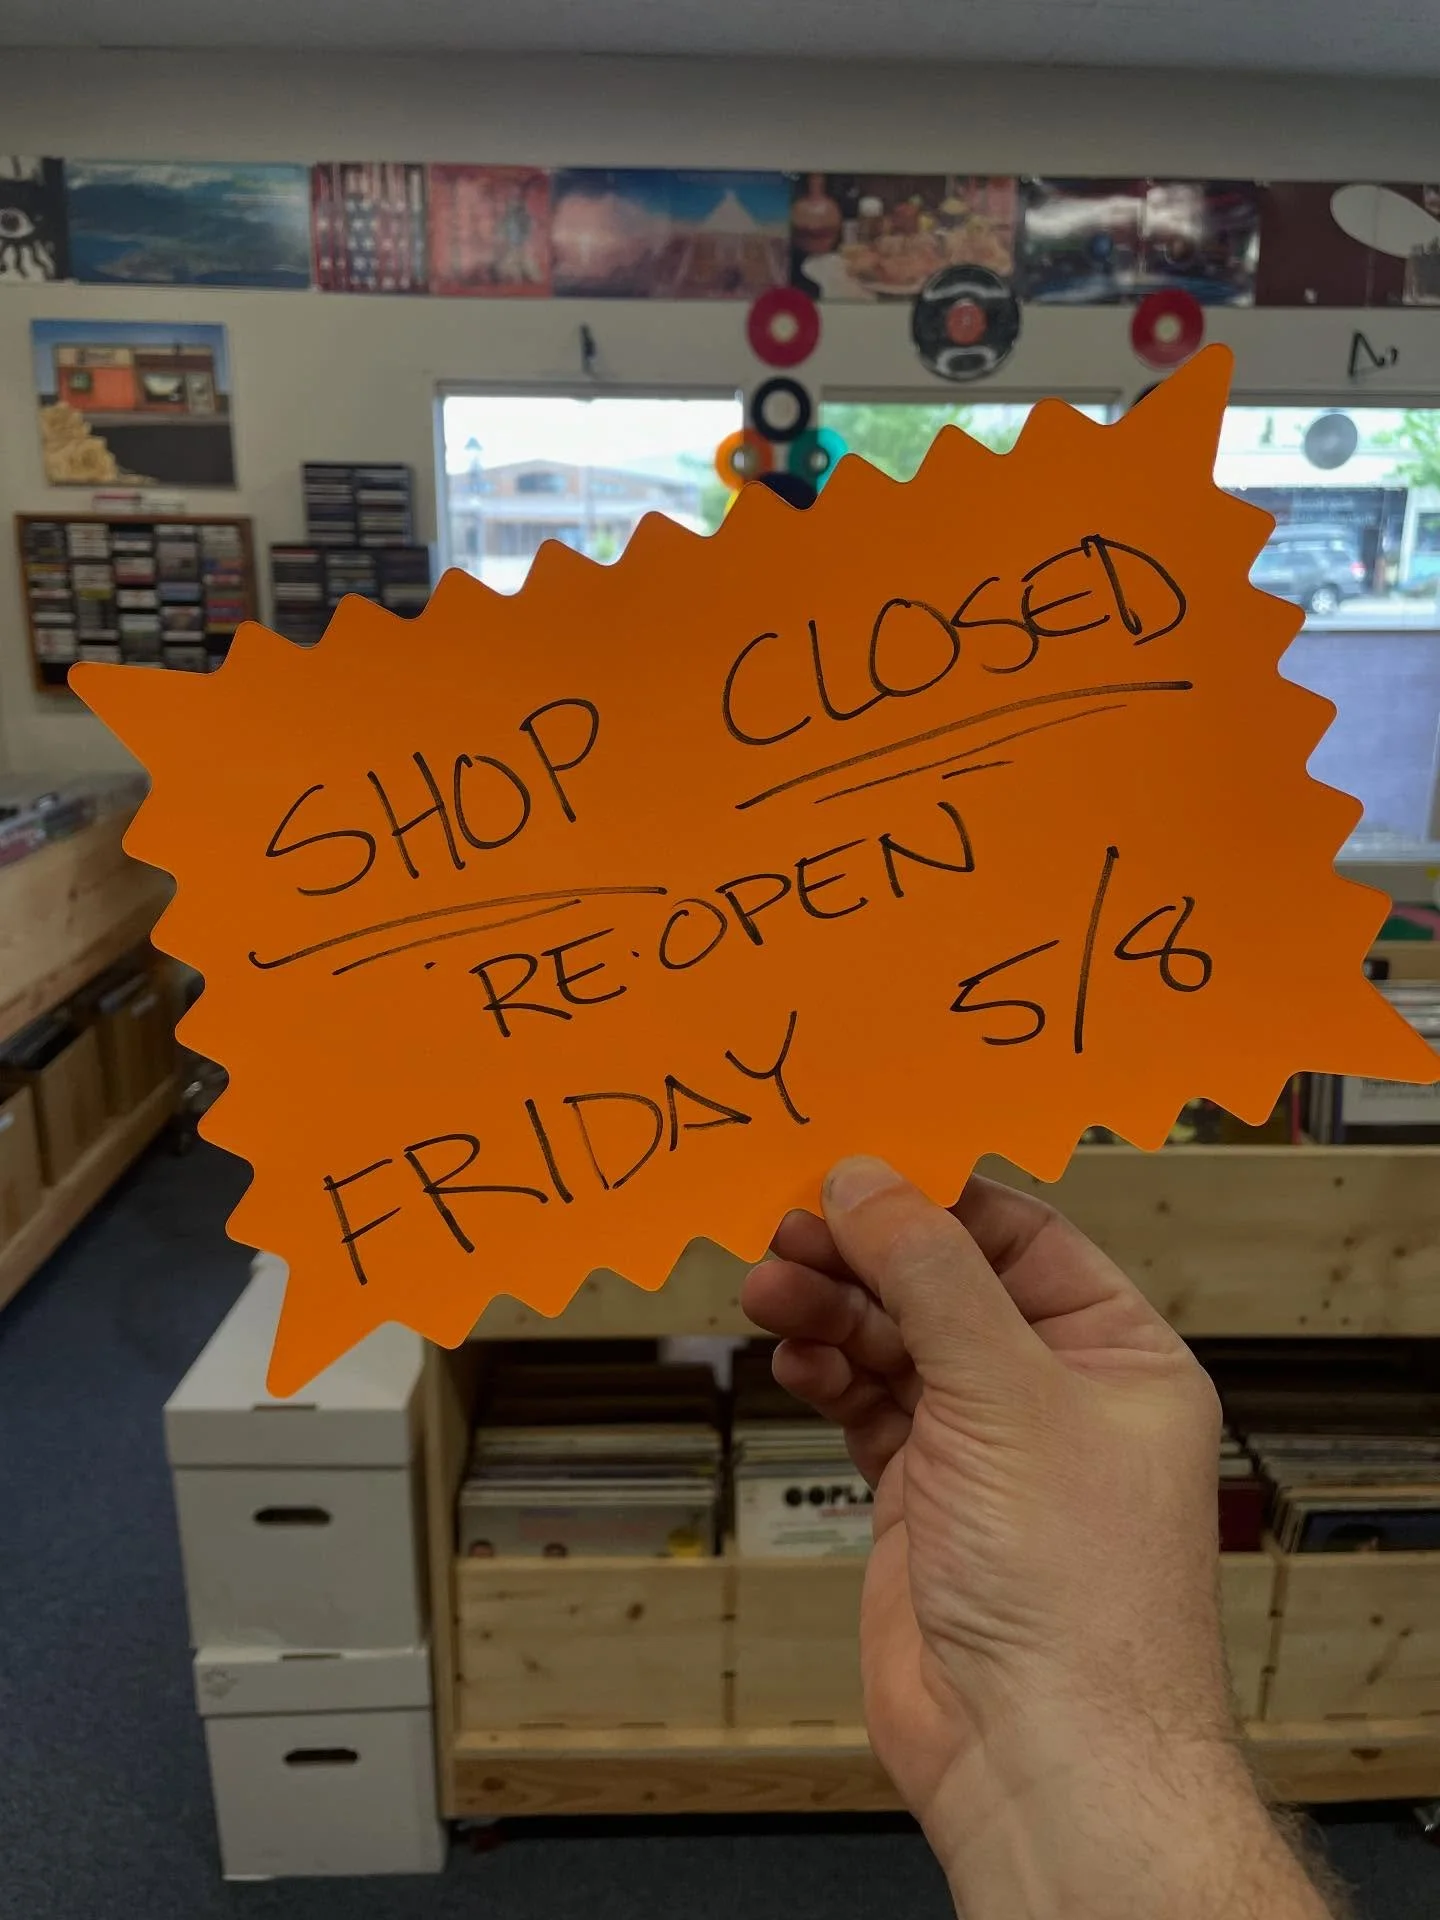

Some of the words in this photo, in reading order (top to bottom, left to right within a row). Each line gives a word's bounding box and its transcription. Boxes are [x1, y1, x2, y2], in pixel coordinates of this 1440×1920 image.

[266, 699, 600, 896] SHOP
[723, 534, 1188, 746] CLOSED
[323, 1010, 811, 1287] FRIDAY
[949, 845, 1213, 1054] 5/8
